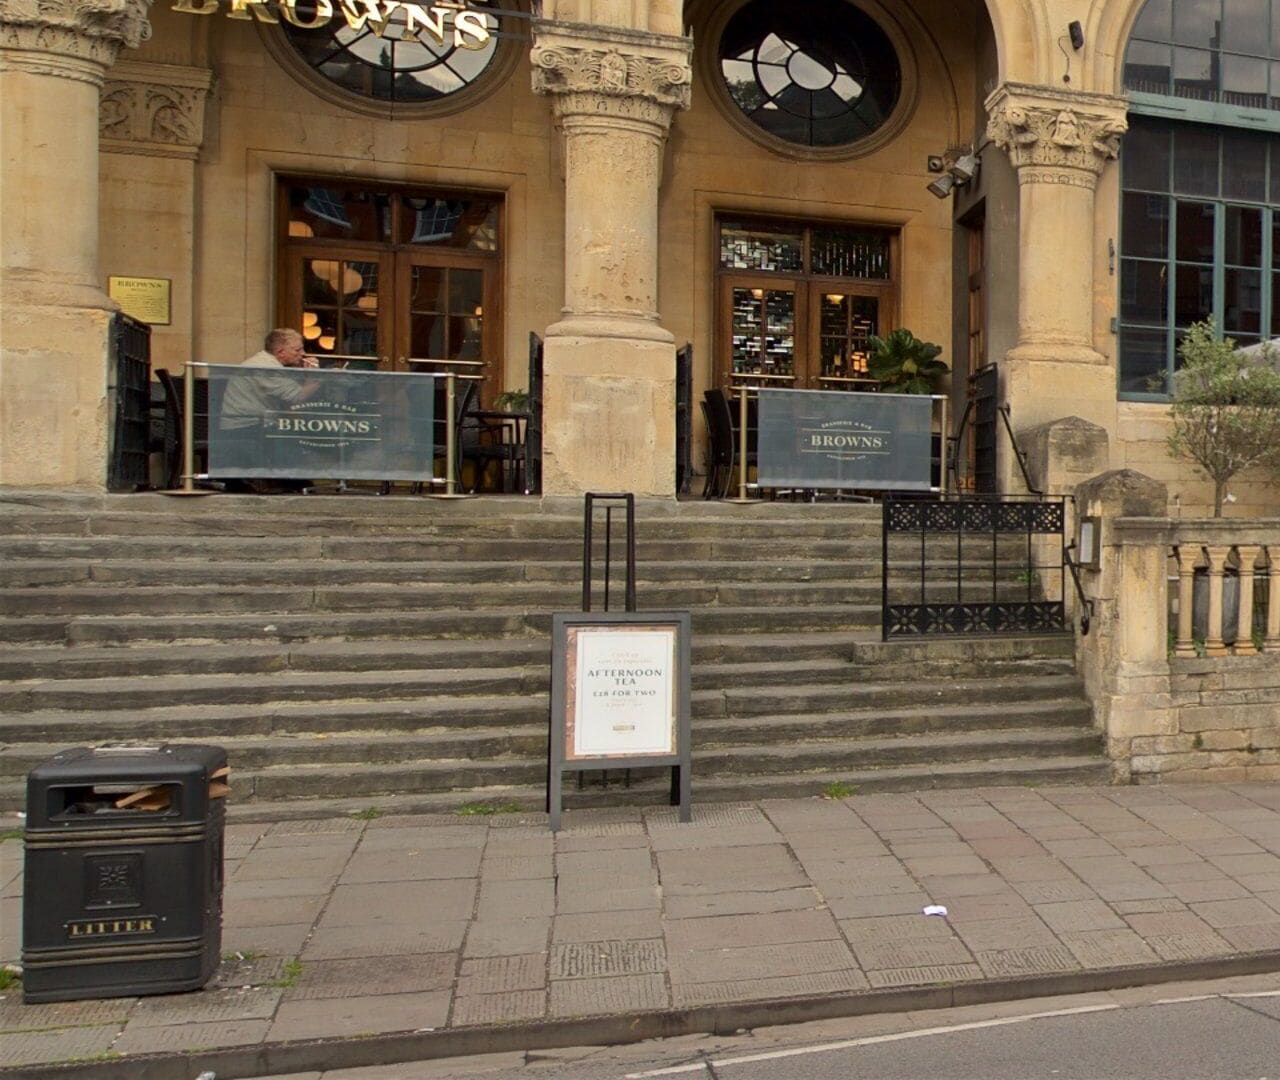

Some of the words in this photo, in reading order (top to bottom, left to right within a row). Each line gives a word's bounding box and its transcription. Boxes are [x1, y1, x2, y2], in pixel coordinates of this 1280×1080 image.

[278, 418, 370, 433] BROWNS
[811, 435, 882, 448] BROWNS
[587, 669, 663, 678] AFTERNOON
[615, 678, 636, 686] TEA
[71, 920, 153, 936] LITTER
